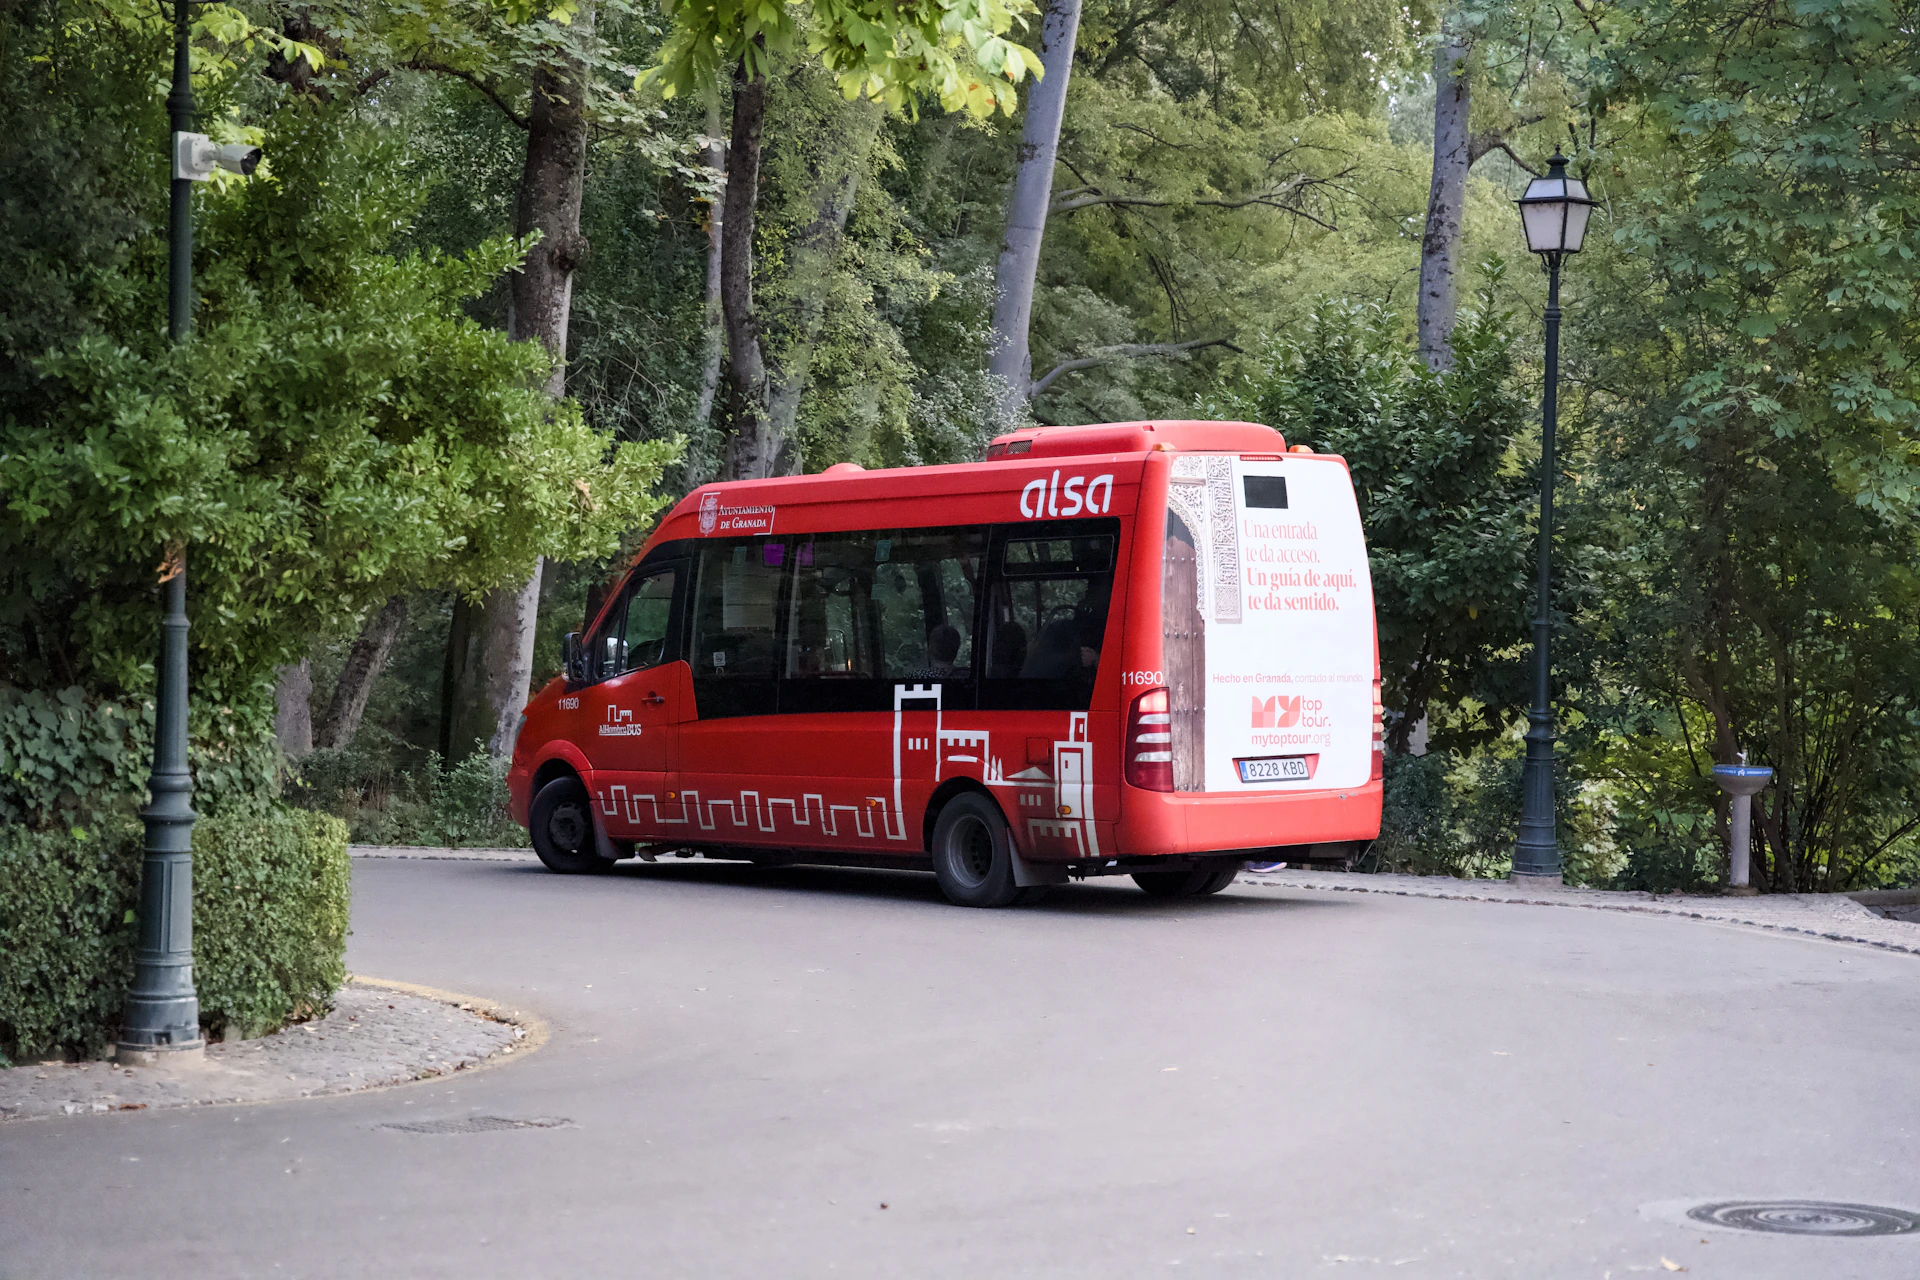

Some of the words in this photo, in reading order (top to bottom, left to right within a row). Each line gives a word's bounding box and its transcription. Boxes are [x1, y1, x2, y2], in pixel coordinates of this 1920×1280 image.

[1020, 469, 1114, 519] alsa
[718, 505, 774, 516] AYUNTAMIENTO
[732, 517, 767, 529] GRANADA
[1243, 519, 1270, 538] Una
[1272, 521, 1318, 540] entrada
[1245, 546, 1257, 562] te
[1260, 544, 1275, 563] da
[1277, 548, 1320, 563] acceso.
[1247, 567, 1267, 586] Un
[1270, 567, 1302, 591] guía
[1304, 569, 1320, 587] de
[1323, 568, 1357, 592] aquí,
[1248, 594, 1262, 610] te
[1264, 592, 1282, 611] da
[1284, 592, 1339, 611] sentido.
[1121, 670, 1163, 685] 11690
[1212, 673, 1241, 683] Hecho
[1243, 675, 1254, 683] en
[1255, 673, 1294, 685] Granada,
[1295, 674, 1327, 683] contado
[1329, 673, 1335, 683] al
[1337, 673, 1365, 683] mundo.
[558, 697, 580, 710] 11690
[1302, 695, 1322, 715] top
[1302, 716, 1332, 727] tour.
[1251, 732, 1331, 747] mytoptour.org
[1249, 763, 1280, 777] 8228
[1282, 761, 1305, 776] KBD
